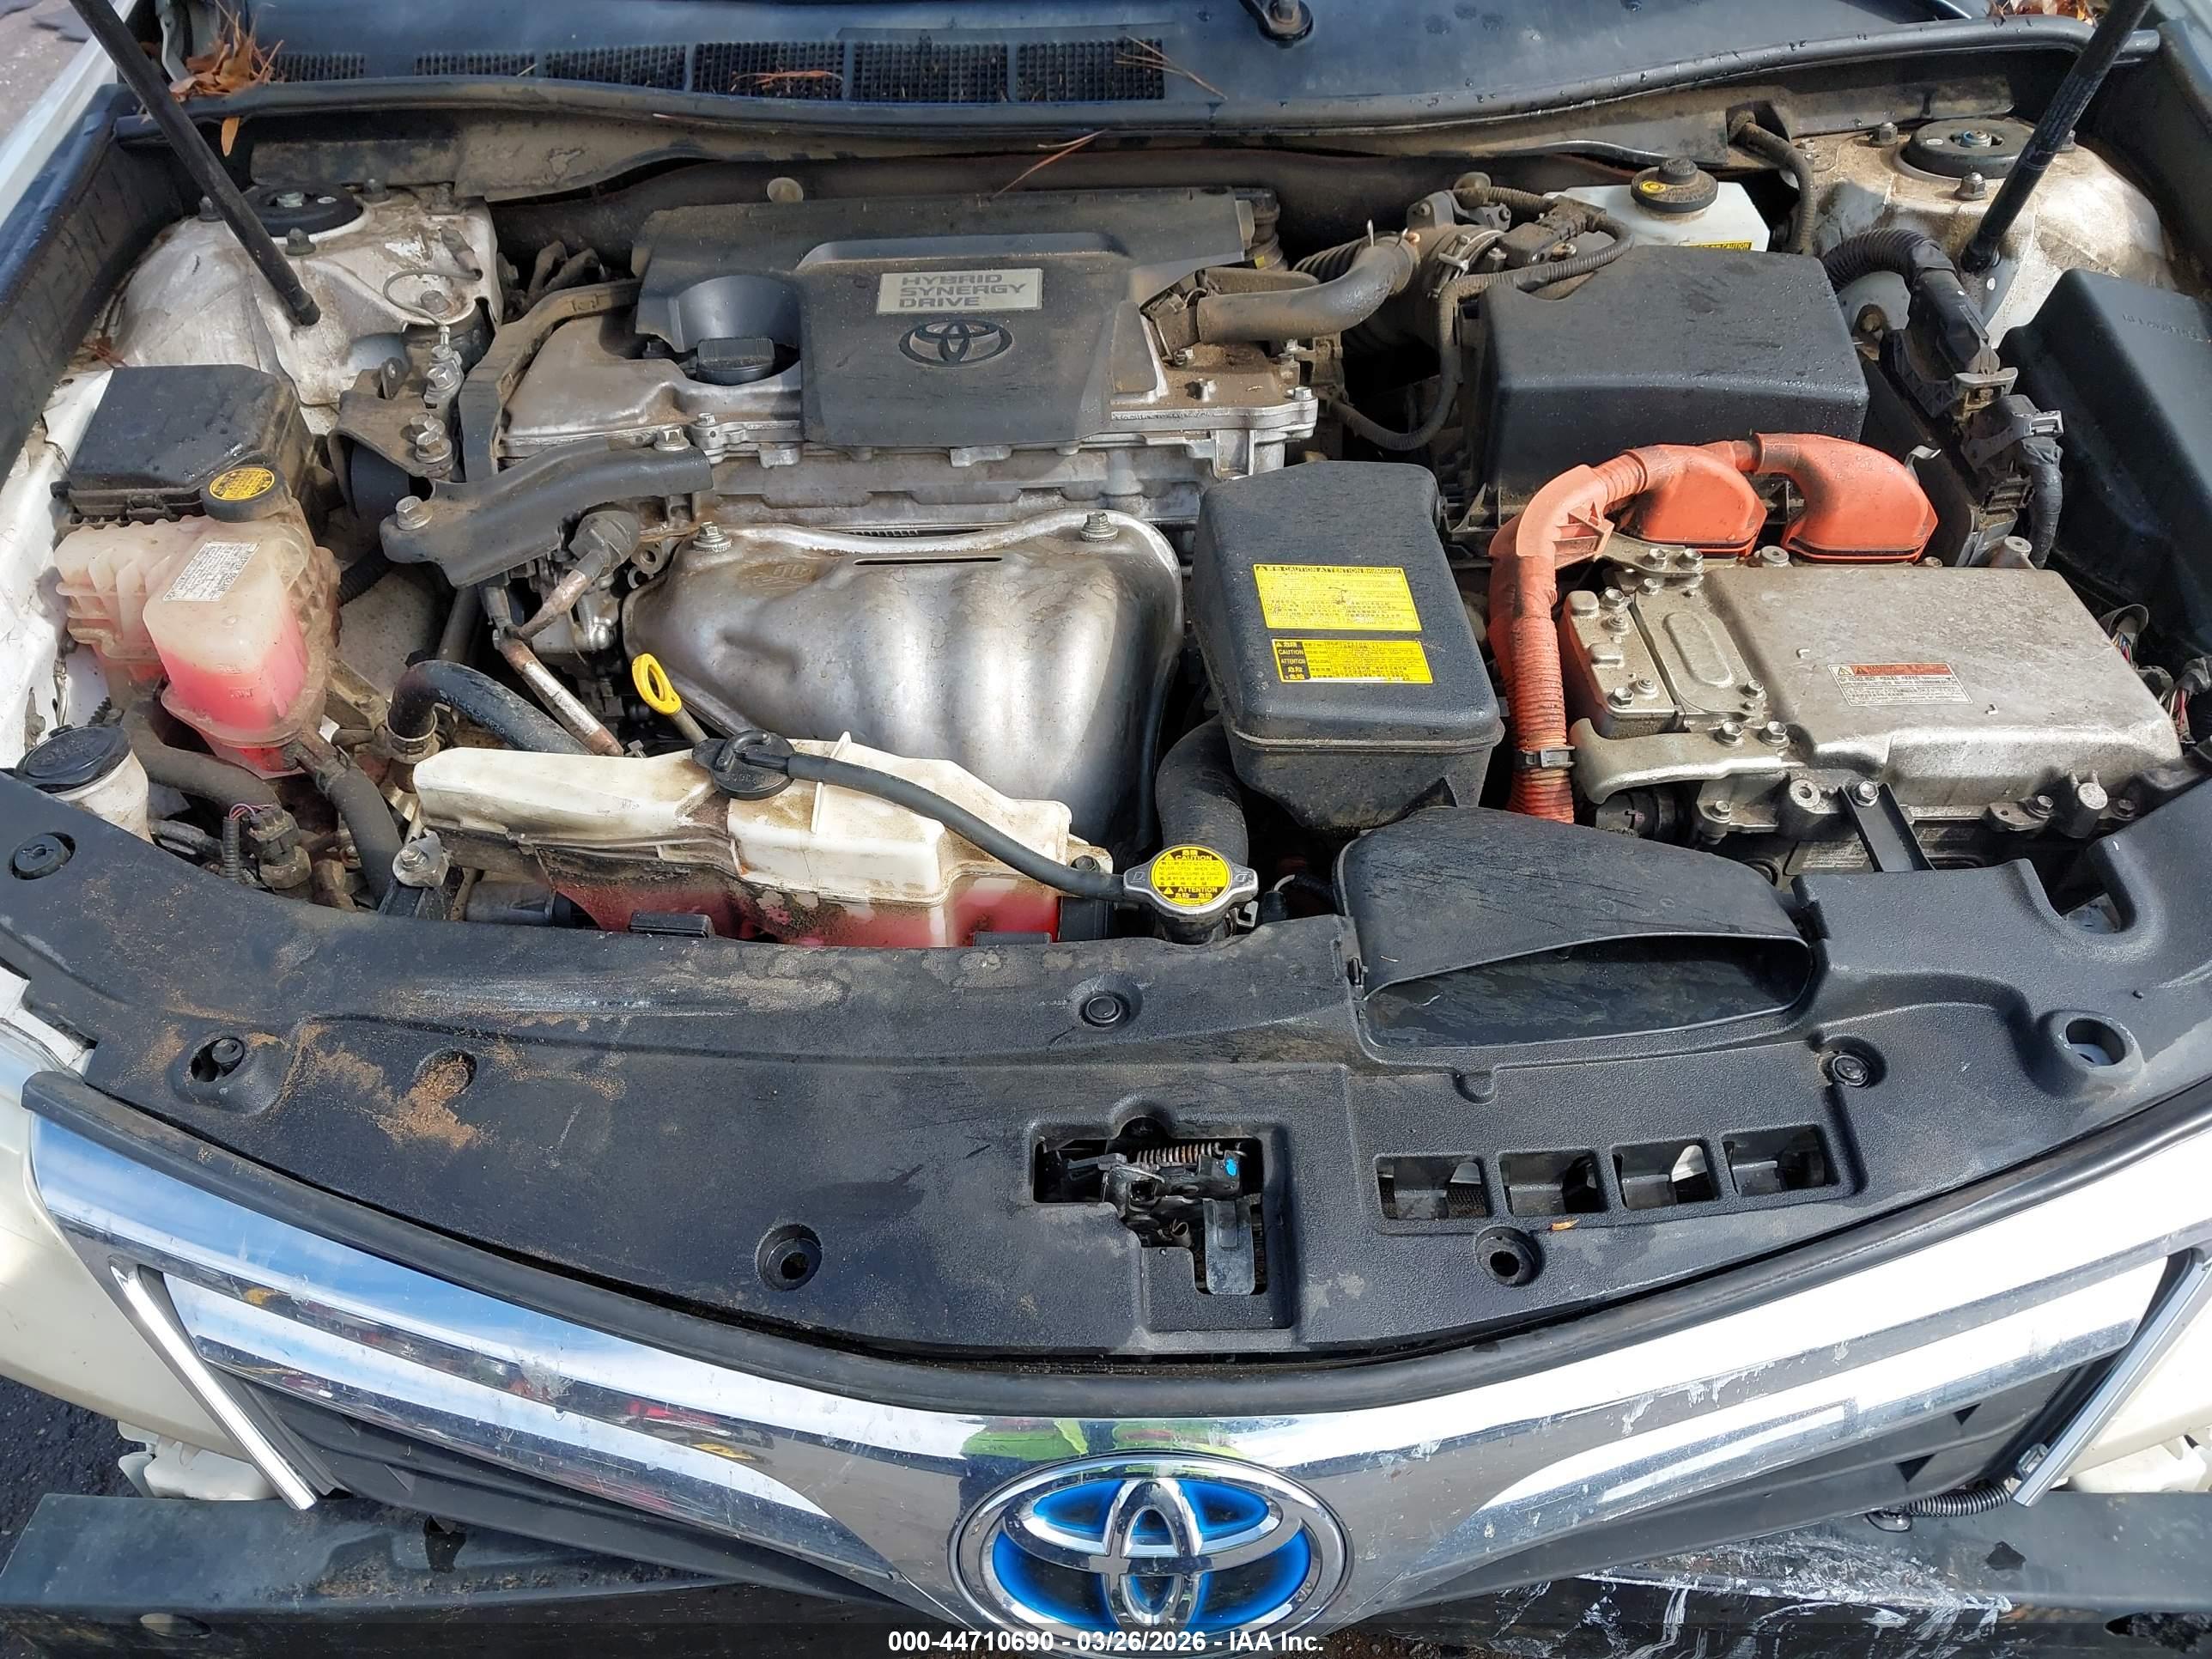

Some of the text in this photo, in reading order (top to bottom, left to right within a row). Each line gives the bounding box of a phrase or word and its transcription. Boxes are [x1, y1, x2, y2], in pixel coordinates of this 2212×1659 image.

[902, 274, 1003, 286] HYBRID
[900, 283, 1027, 296] SYNERGY
[899, 296, 981, 308] DRIVE
